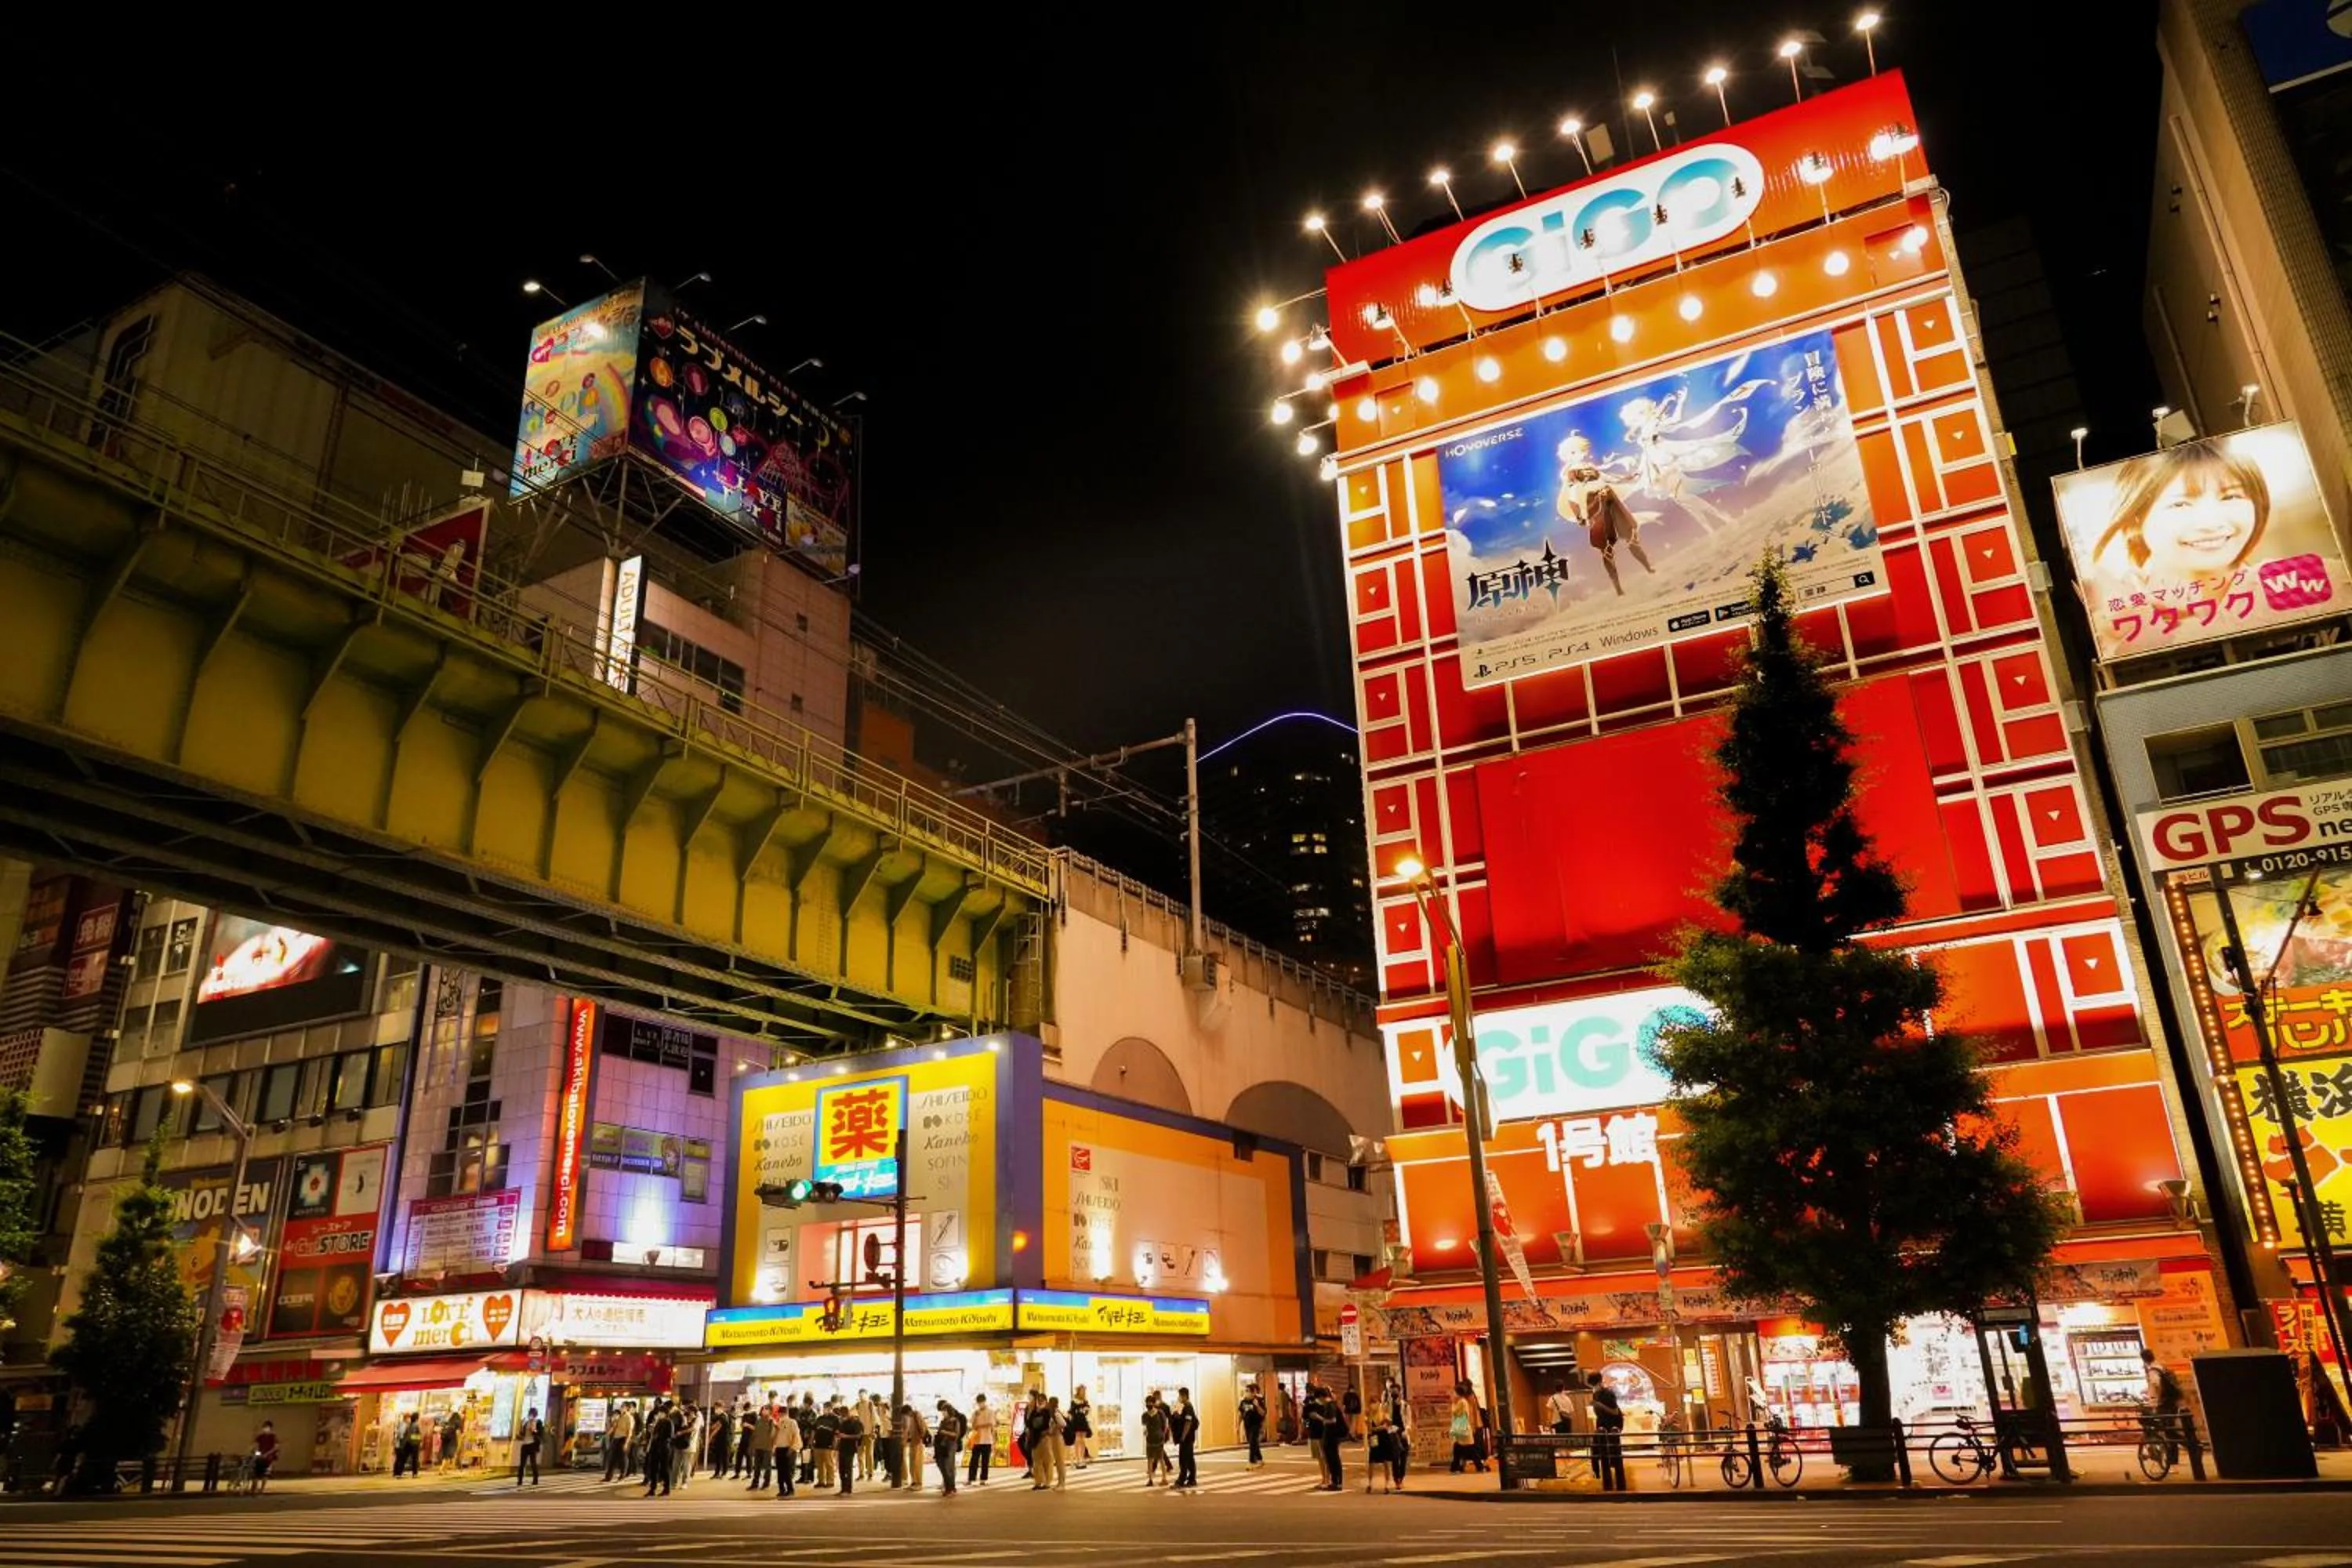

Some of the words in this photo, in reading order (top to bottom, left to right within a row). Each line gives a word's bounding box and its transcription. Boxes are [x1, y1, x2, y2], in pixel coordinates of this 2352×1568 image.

[1445, 427, 1523, 458] HOYOVERSE
[2107, 571, 2247, 612] 恋愛マッチング
[1548, 641, 1590, 659] PS4
[1599, 626, 1658, 648] Windows
[1495, 654, 1536, 672] PS5
[2314, 804, 2340, 816] GPS
[2152, 796, 2310, 861] GPS
[830, 1089, 889, 1159] 薬
[924, 1131, 979, 1150] Kanebo
[1537, 1112, 1658, 1172] 1号館
[754, 1155, 802, 1172] Kanebo
[167, 1181, 270, 1221] NODEN
